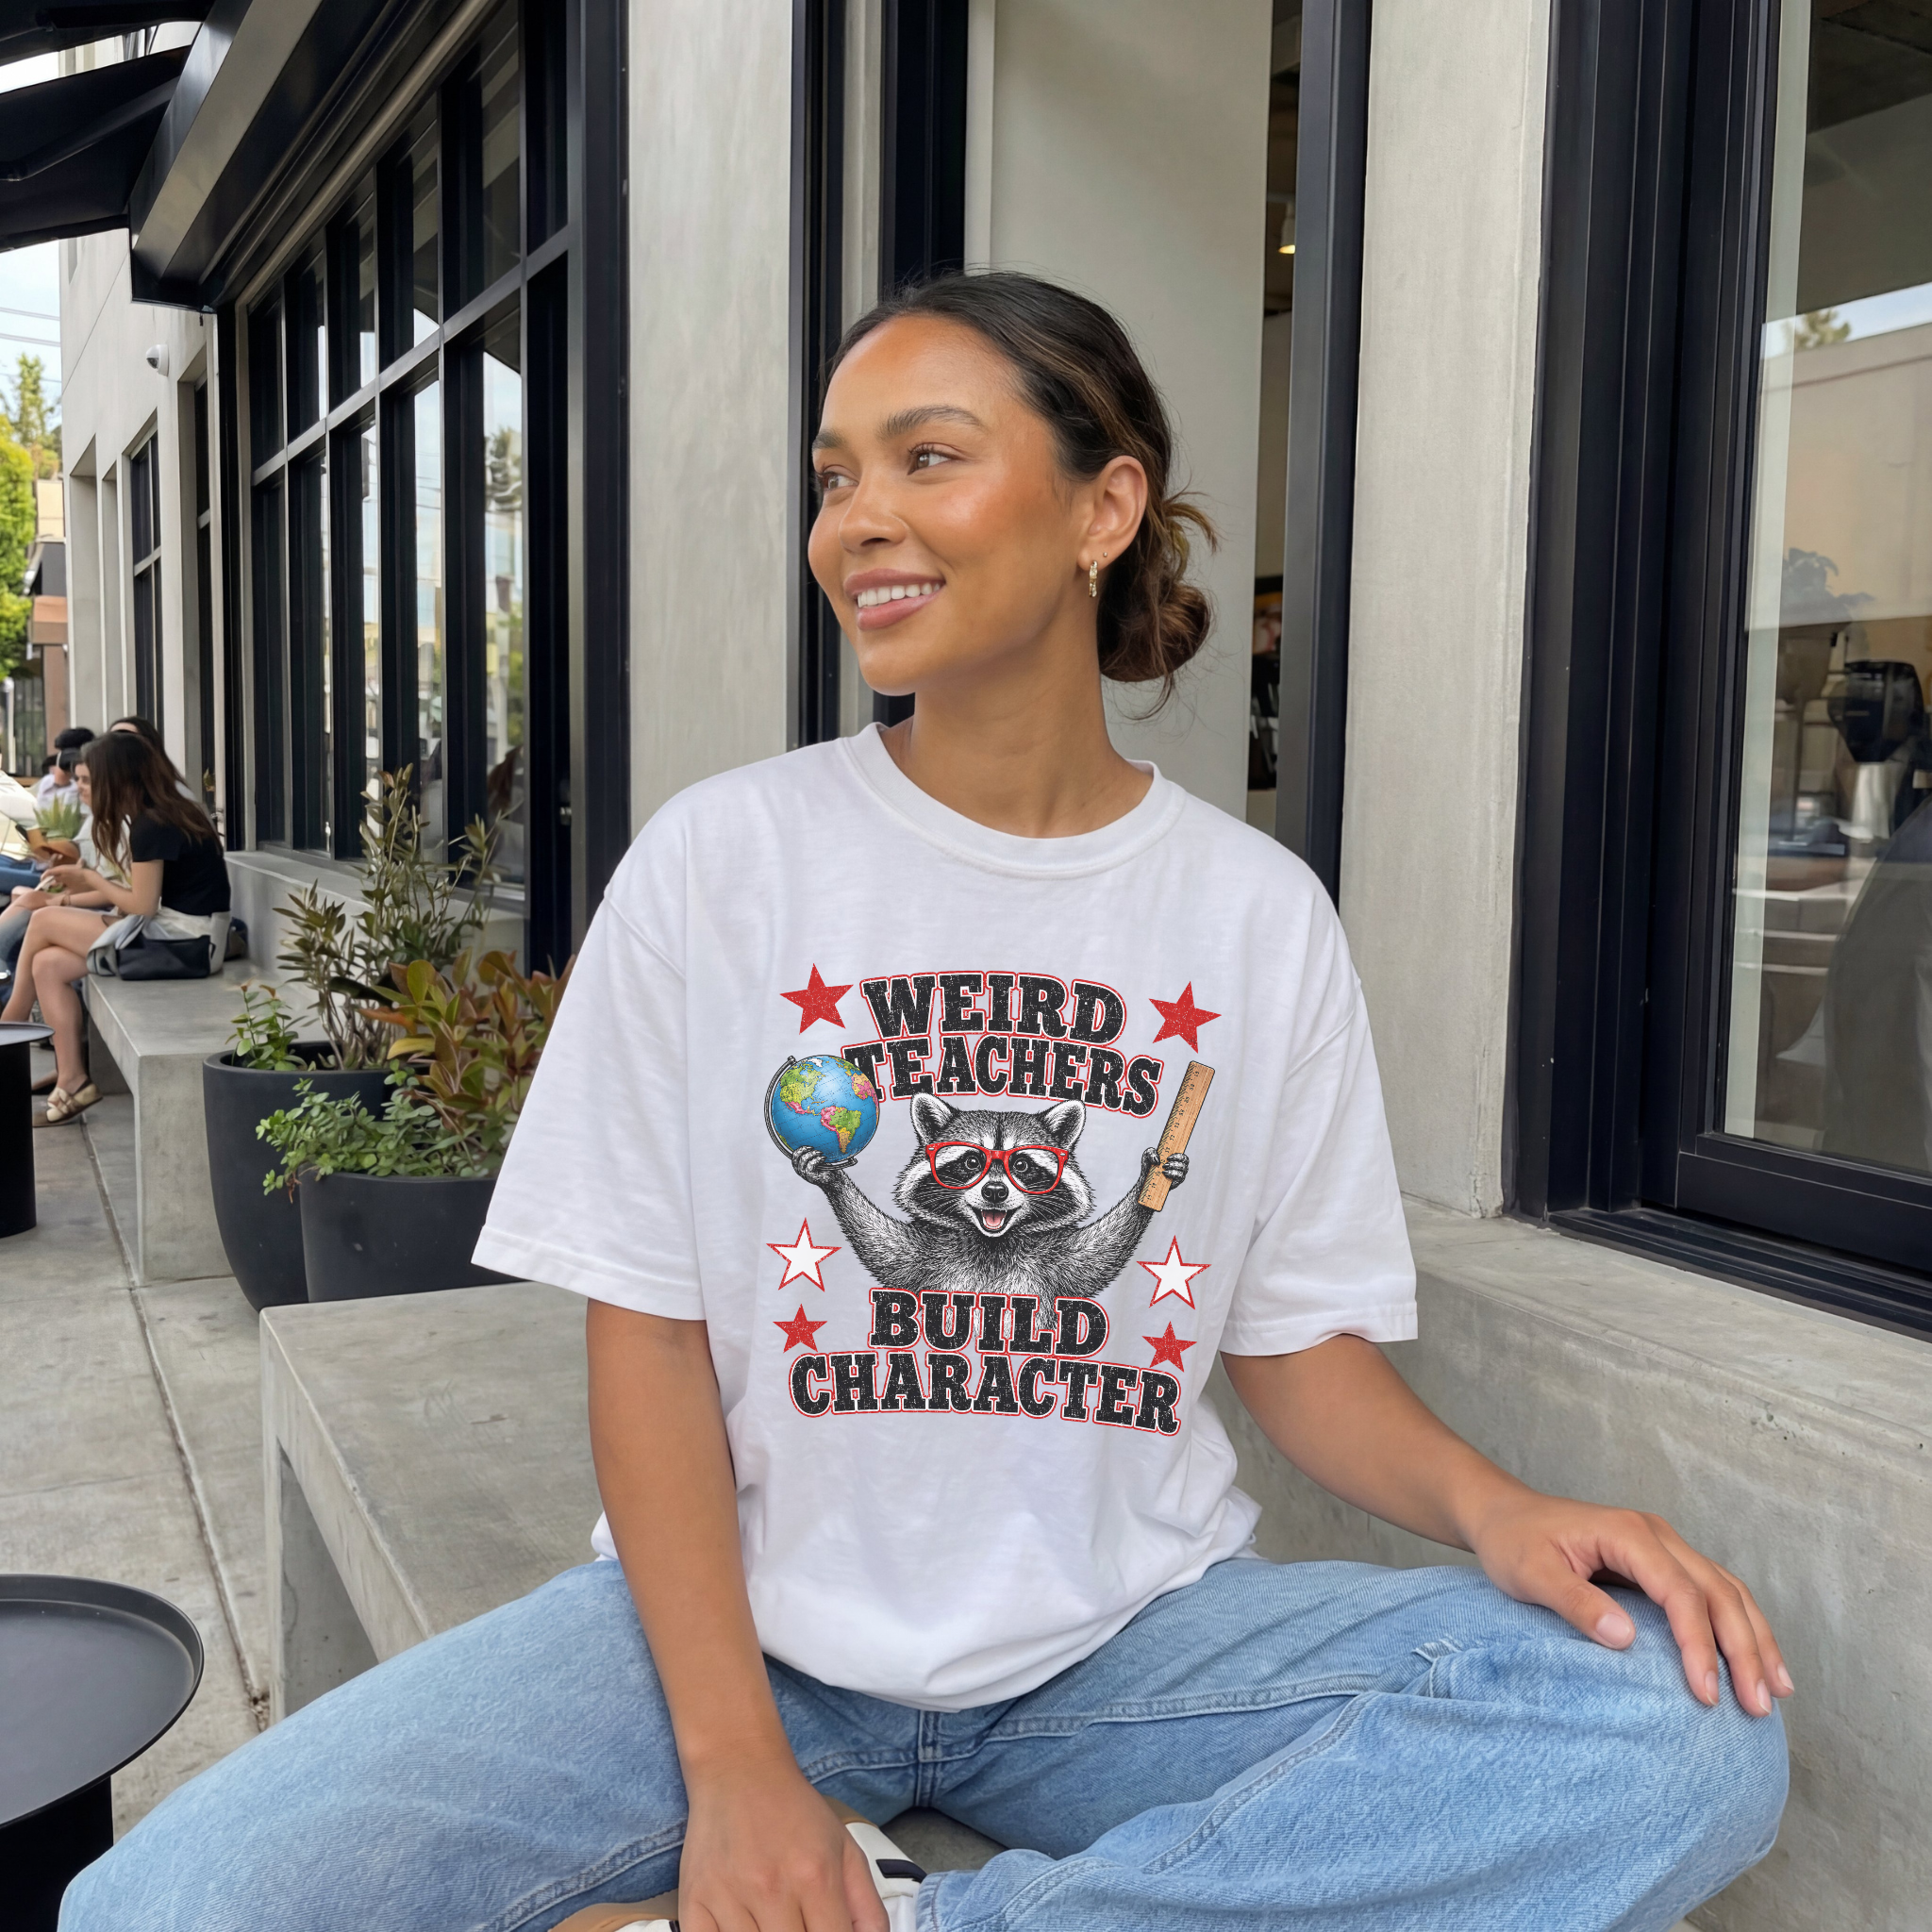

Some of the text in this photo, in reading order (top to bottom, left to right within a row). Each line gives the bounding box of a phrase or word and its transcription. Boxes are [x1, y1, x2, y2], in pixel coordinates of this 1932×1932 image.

[861, 972, 1125, 1047] WEIRD
[841, 1036, 1163, 1117] TEACHERS
[869, 1289, 1108, 1357] BUILD
[790, 1352, 1182, 1436] CHARACTER
